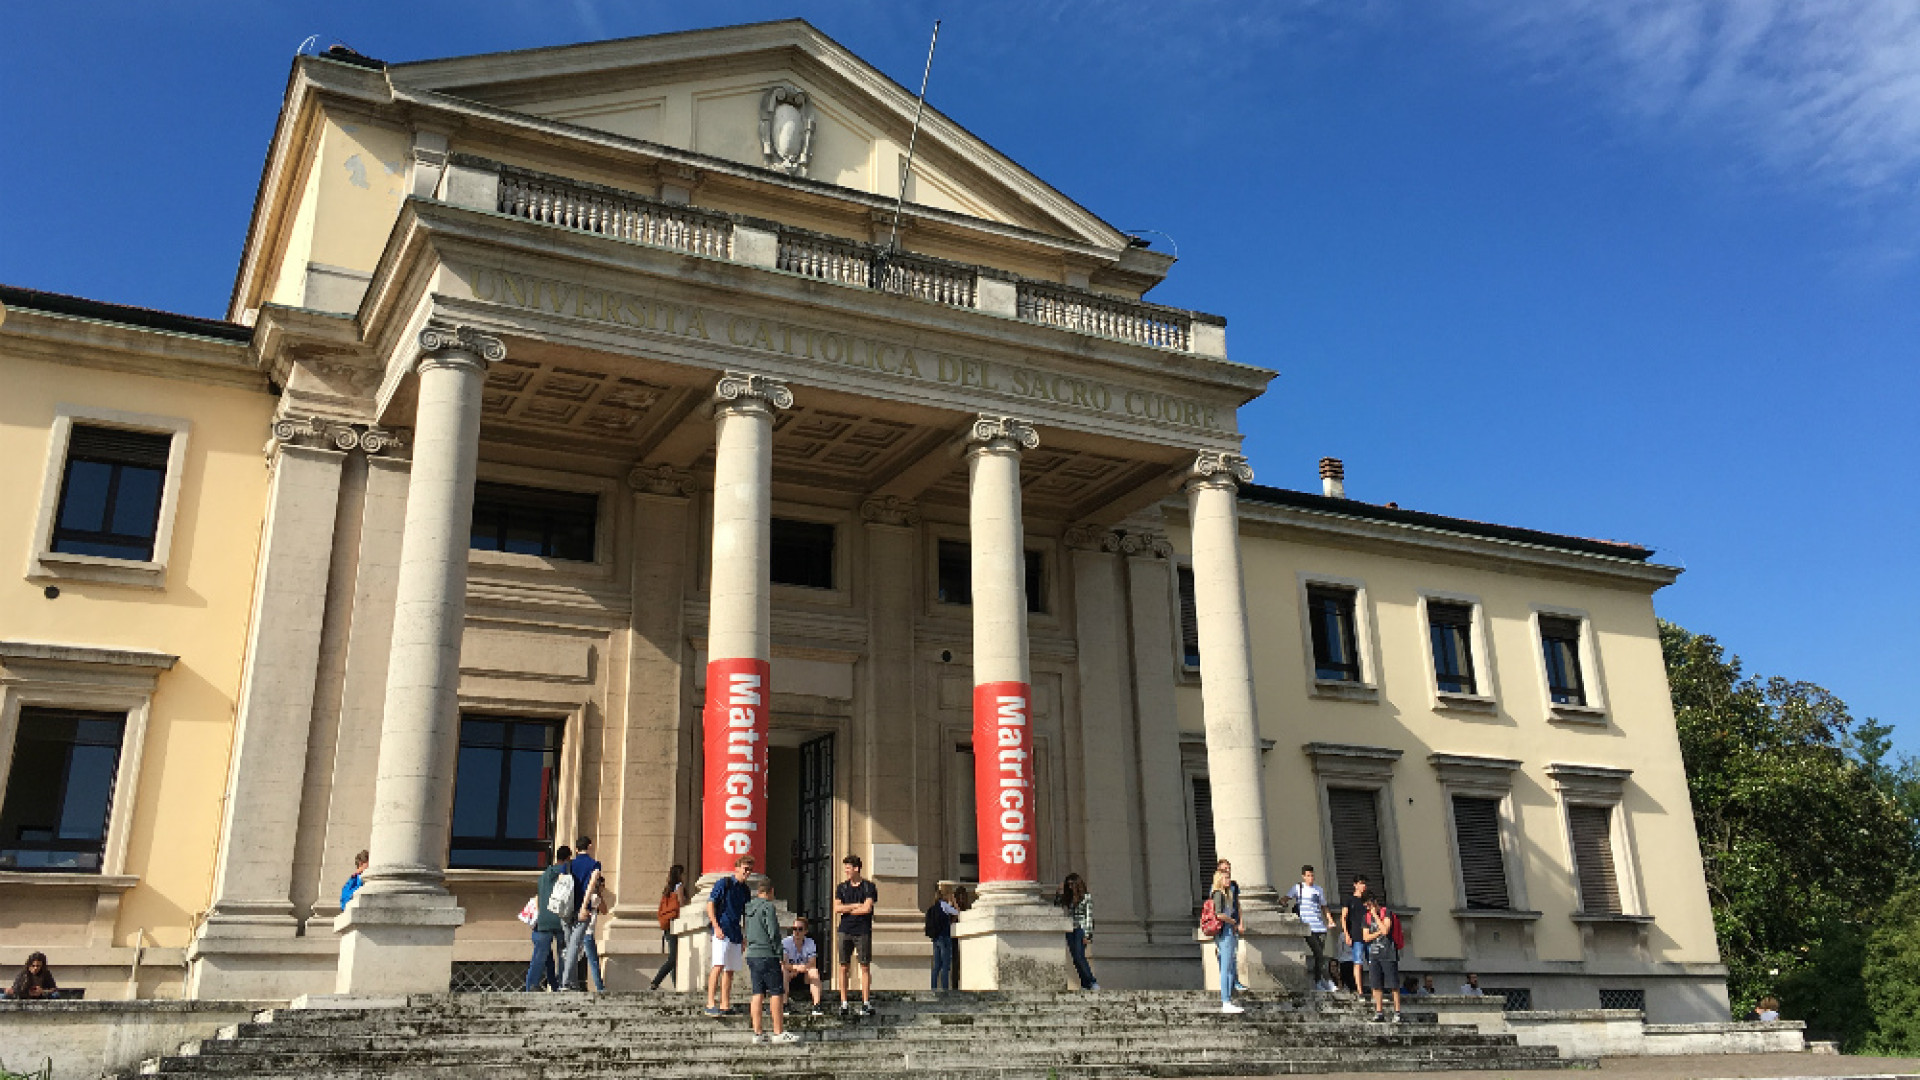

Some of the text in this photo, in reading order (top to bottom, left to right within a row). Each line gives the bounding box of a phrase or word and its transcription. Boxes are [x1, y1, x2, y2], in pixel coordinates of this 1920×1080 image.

[727, 315, 921, 379] CATTOLICA
[938, 354, 1000, 390] DEL
[1011, 368, 1112, 412] SACRO
[1125, 391, 1221, 430] CUORE
[723, 672, 761, 855] Matricole
[995, 695, 1031, 865] Matricole
